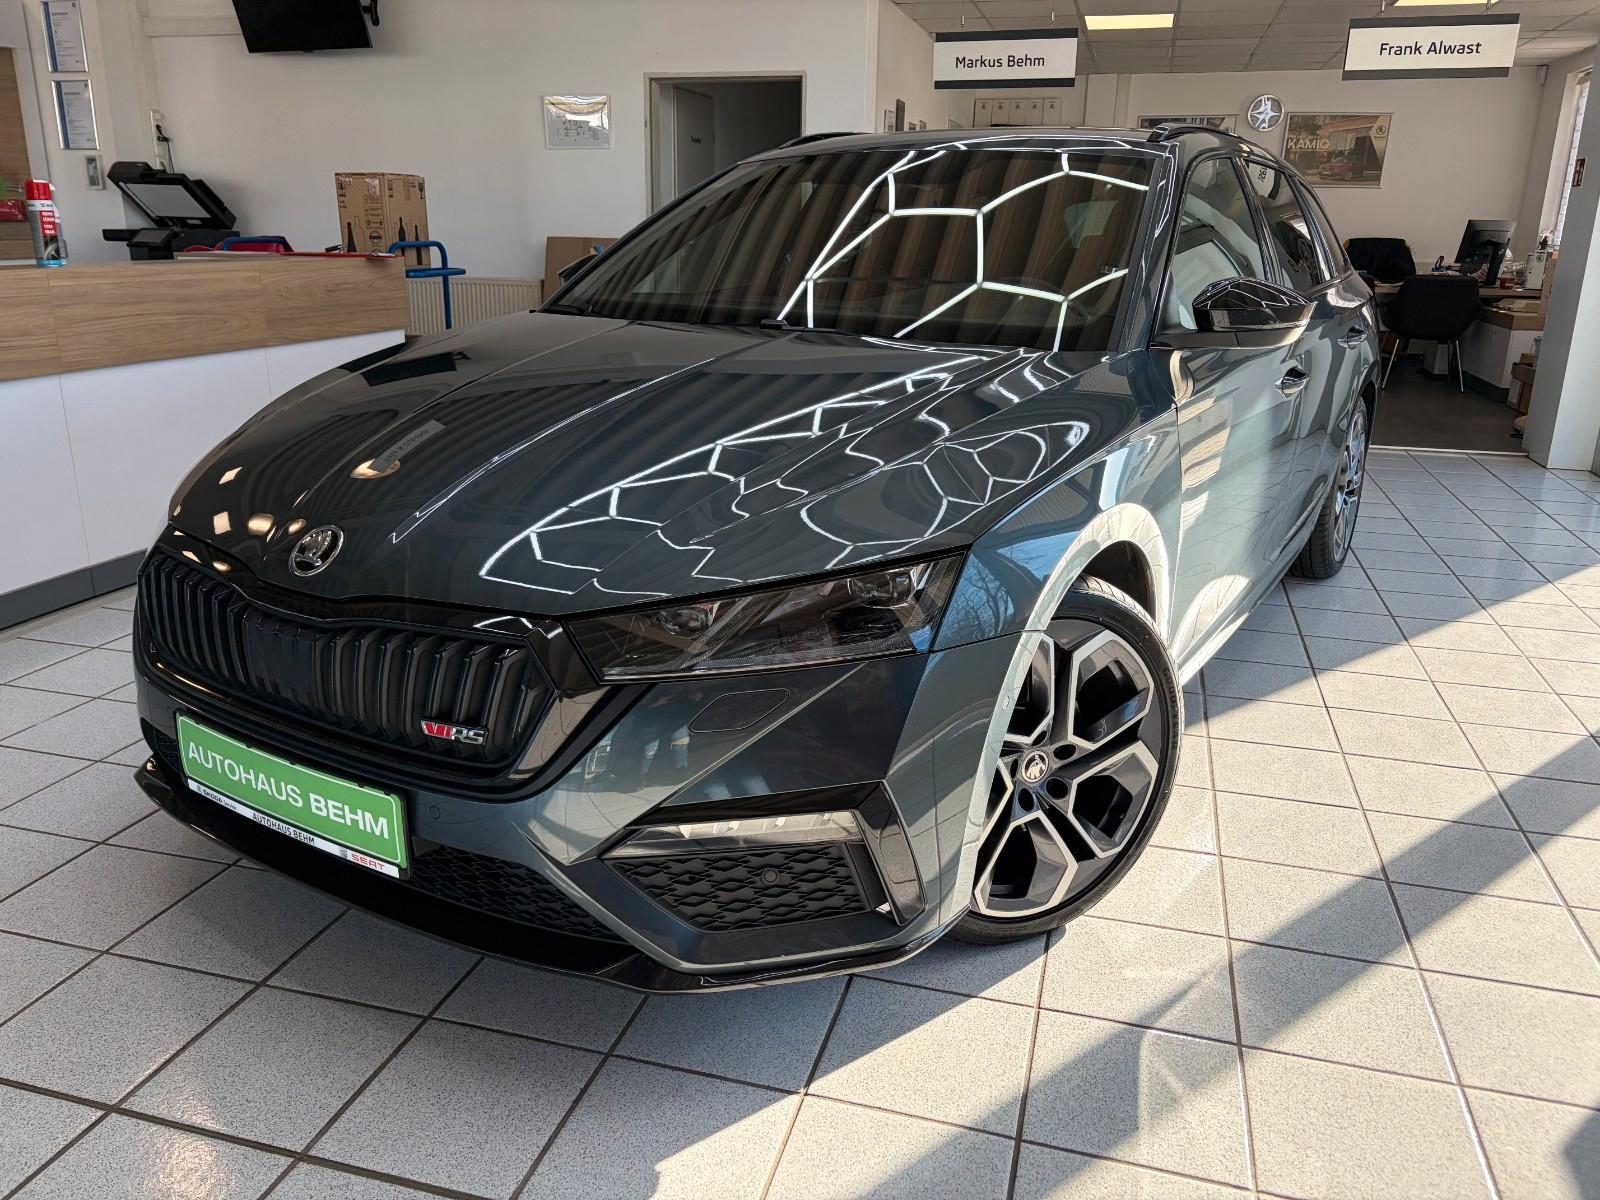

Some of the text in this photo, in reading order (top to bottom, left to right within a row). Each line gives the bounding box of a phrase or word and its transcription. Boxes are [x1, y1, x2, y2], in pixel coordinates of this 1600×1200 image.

[1379, 40, 1482, 56] Frank Alwast
[955, 53, 1045, 69] Markus Behm
[188, 741, 390, 840] AUTOHAUS BEHM
[252, 812, 315, 845] AUTOHAUS BEHM
[351, 853, 385, 871] SEAT
